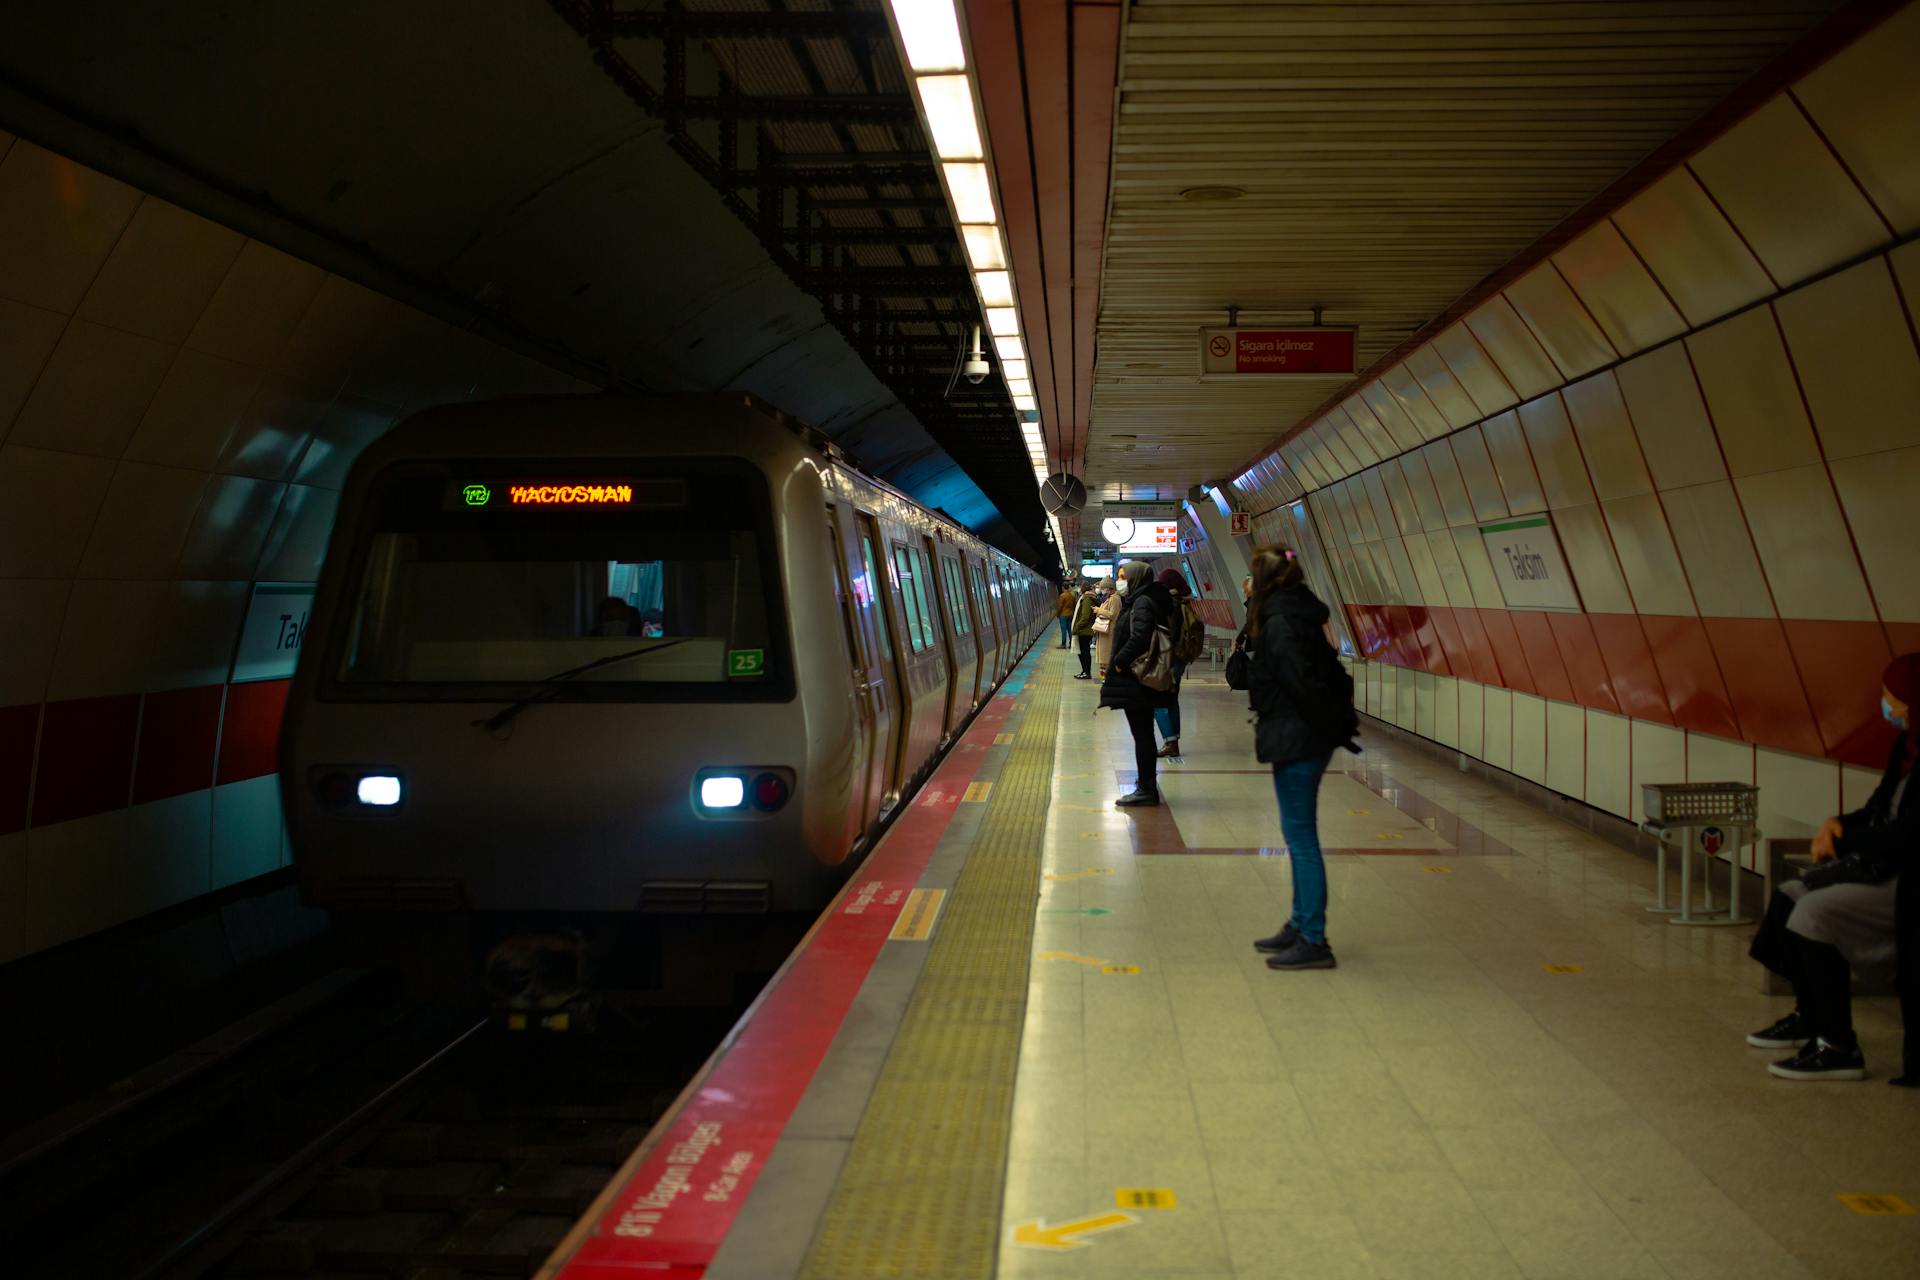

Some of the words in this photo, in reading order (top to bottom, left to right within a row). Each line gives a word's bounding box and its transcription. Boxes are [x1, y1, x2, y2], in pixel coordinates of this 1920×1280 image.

[1239, 339, 1274, 353] Sigara
[1276, 339, 1314, 354] içilmez
[1239, 354, 1251, 363] No
[511, 486, 632, 503] HACIOSMAN
[1504, 543, 1549, 580] Taksim
[276, 611, 309, 650] Tak
[735, 655, 757, 670] 25
